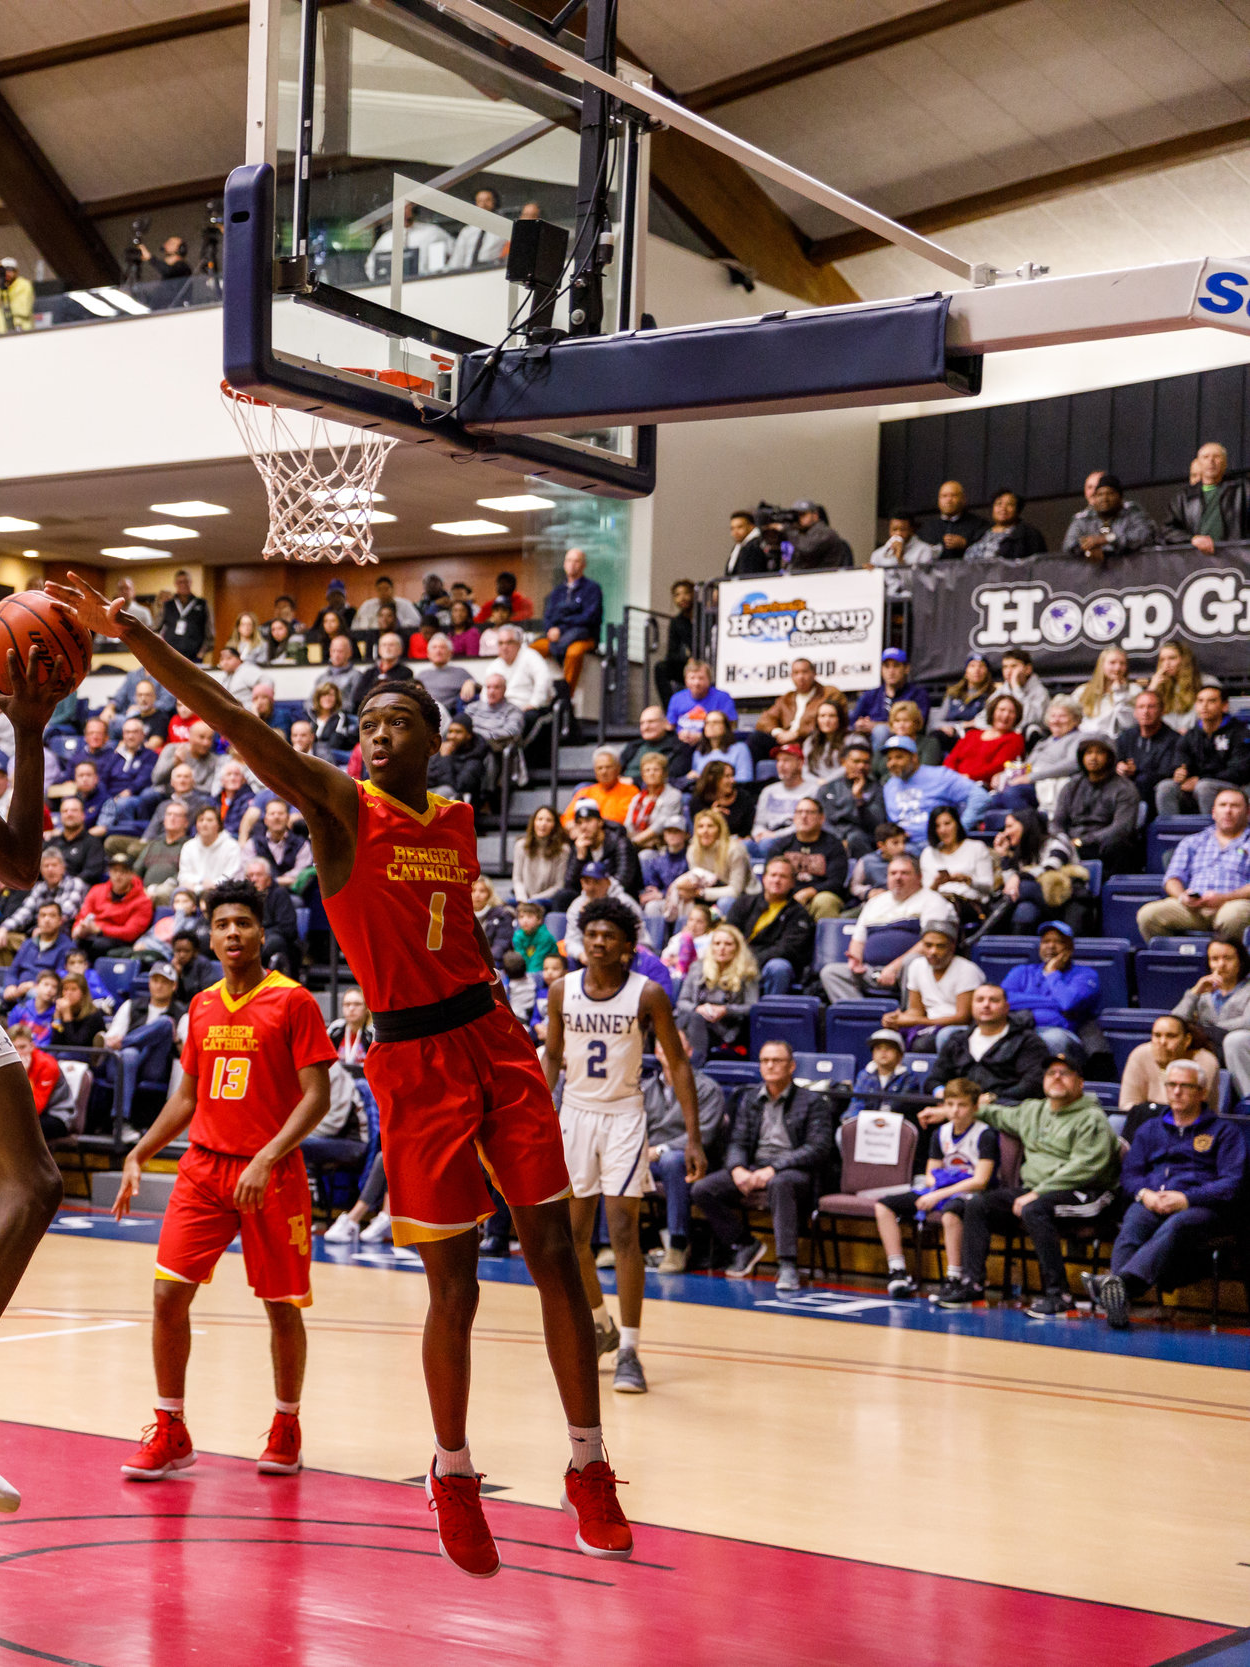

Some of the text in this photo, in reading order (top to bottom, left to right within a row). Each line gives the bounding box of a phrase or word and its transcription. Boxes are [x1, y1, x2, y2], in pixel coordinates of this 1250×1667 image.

[1198, 272, 1250, 317] S
[393, 845, 459, 866] BERGEN
[386, 863, 468, 884] CATHOLIC
[427, 892, 446, 951] 1
[207, 1025, 254, 1039] BERGEN
[562, 1013, 637, 1034] RANNEY
[202, 1037, 259, 1051] CATHOLIC
[587, 1040, 607, 1079] 2
[209, 1056, 251, 1100] 13
